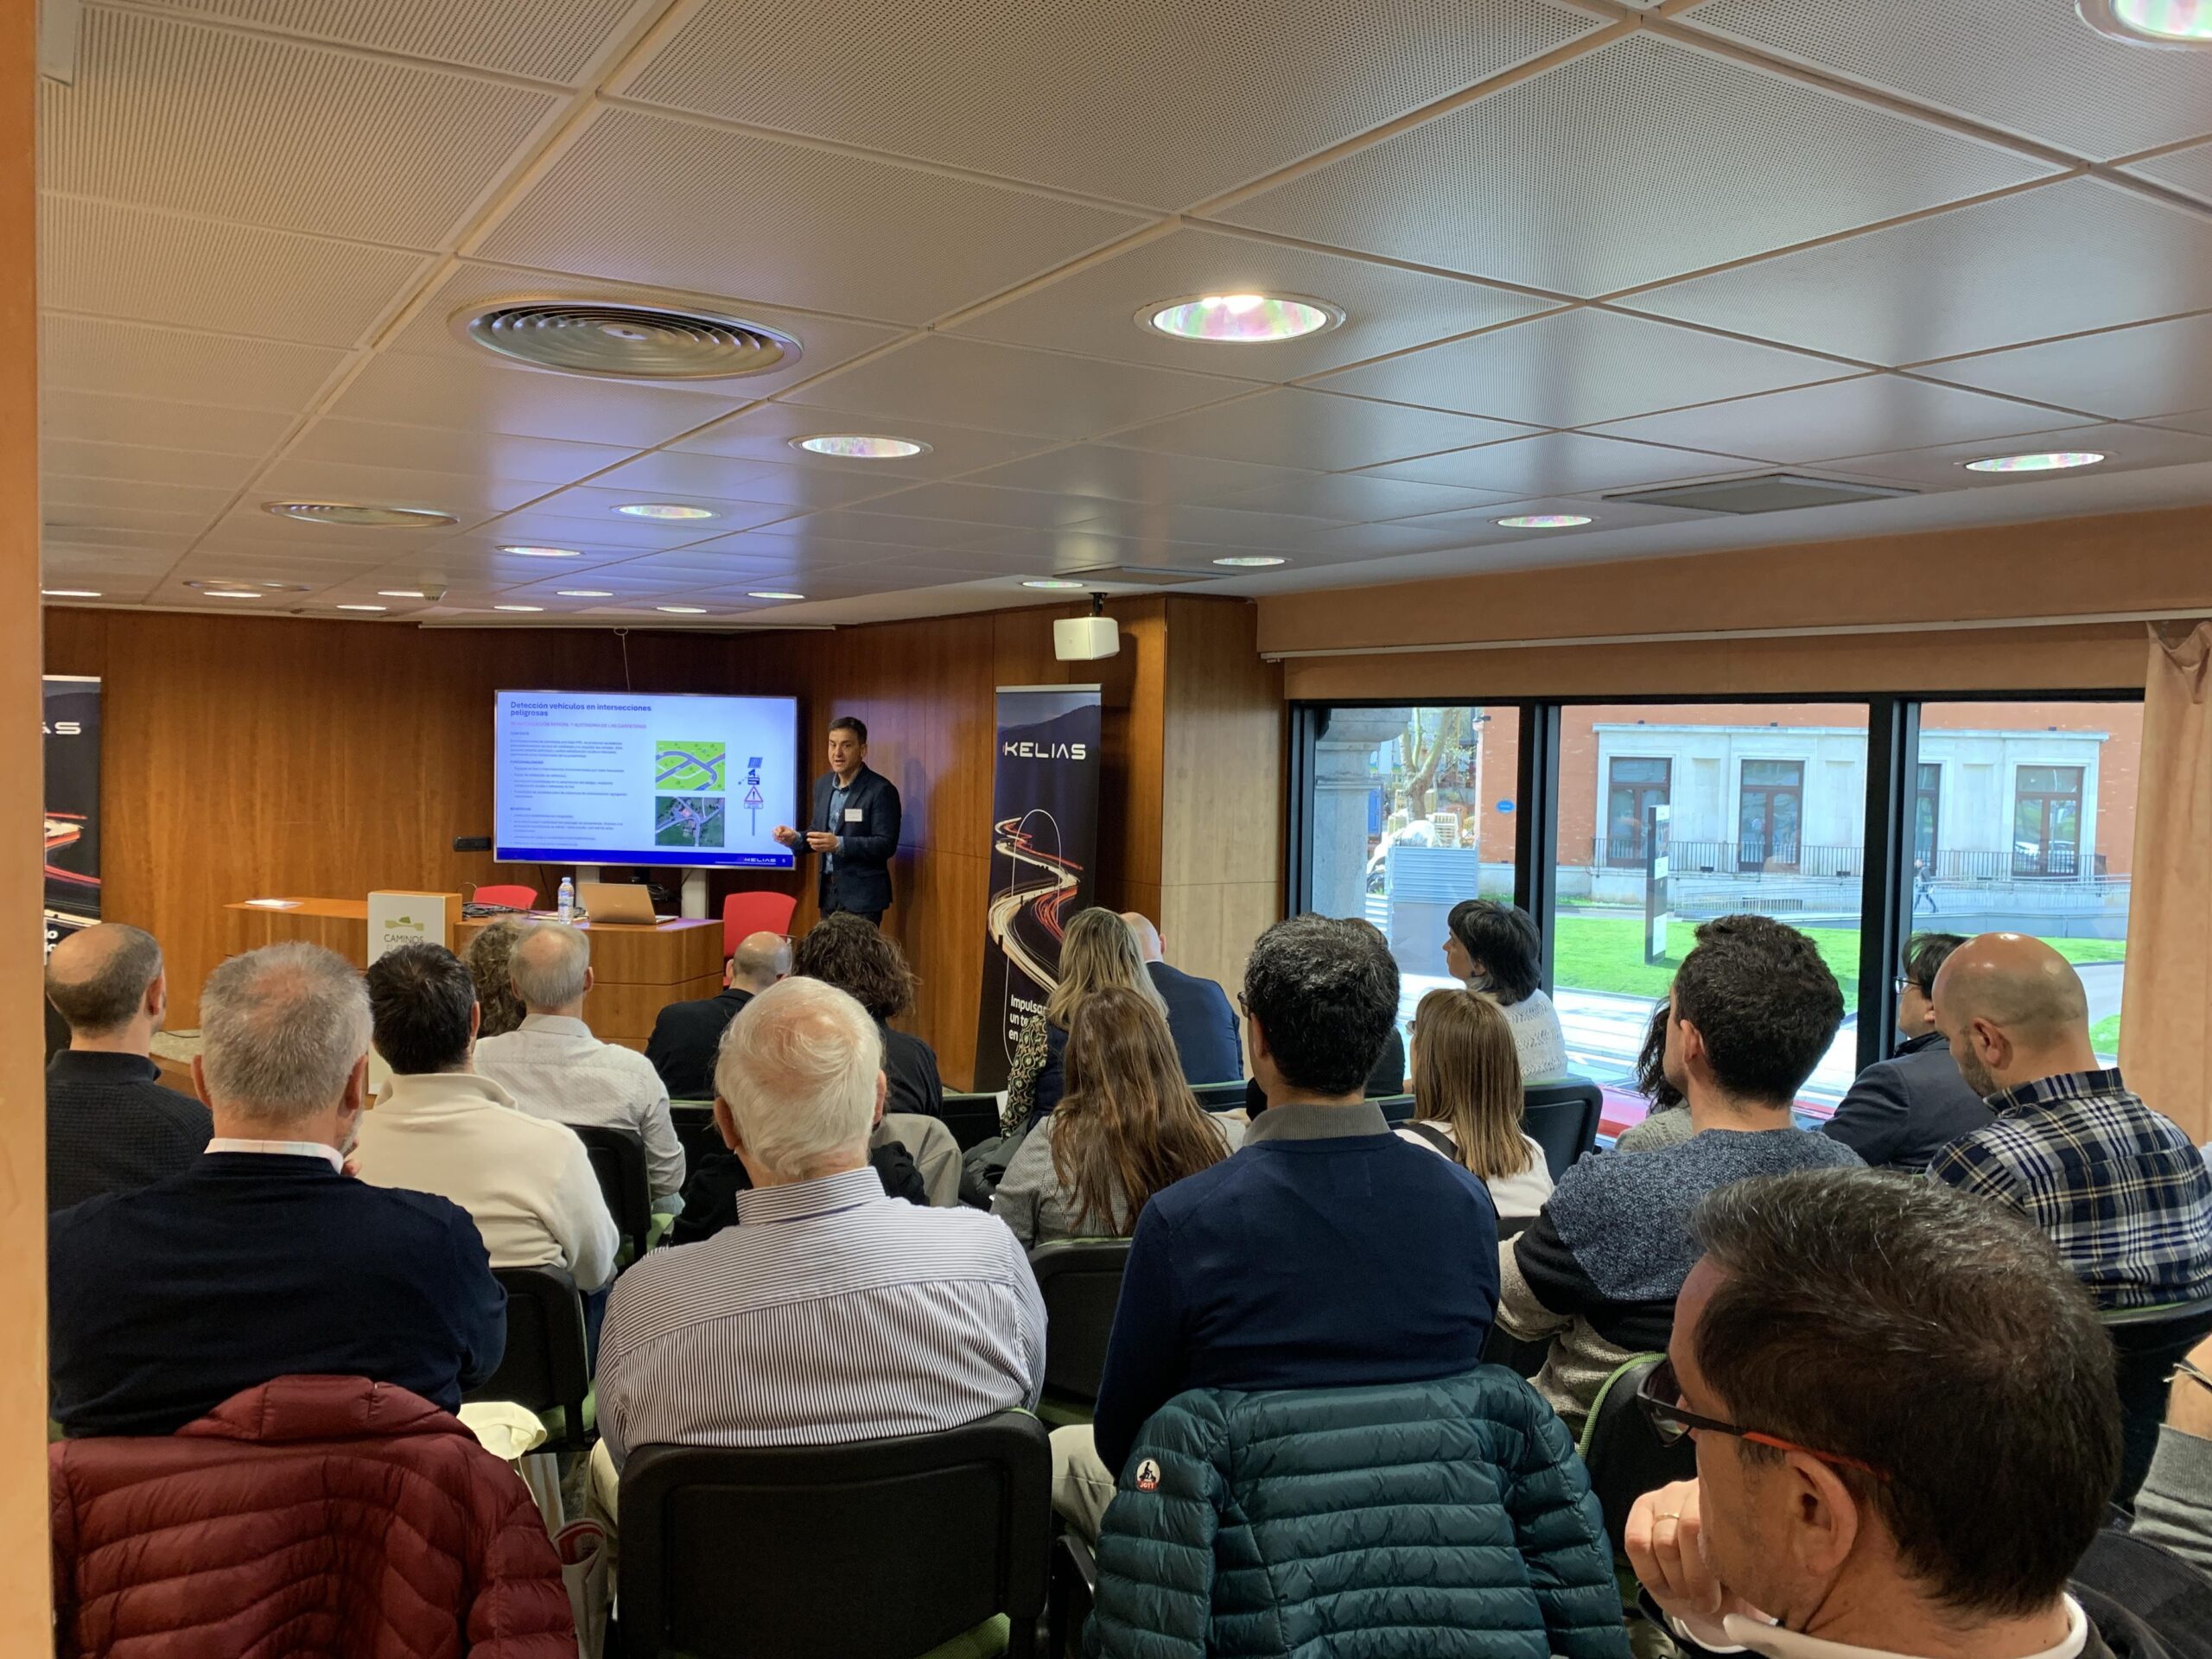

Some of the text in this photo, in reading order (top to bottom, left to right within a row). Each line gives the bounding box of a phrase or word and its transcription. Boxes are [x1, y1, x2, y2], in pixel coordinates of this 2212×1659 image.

[511, 701, 548, 709] Detección
[597, 703, 652, 712] intersecciones
[1003, 742, 1086, 760] KELIAS
[384, 934, 423, 943] CAMINOS
[1009, 1013, 1020, 1025] un
[1008, 1029, 1019, 1041] en
